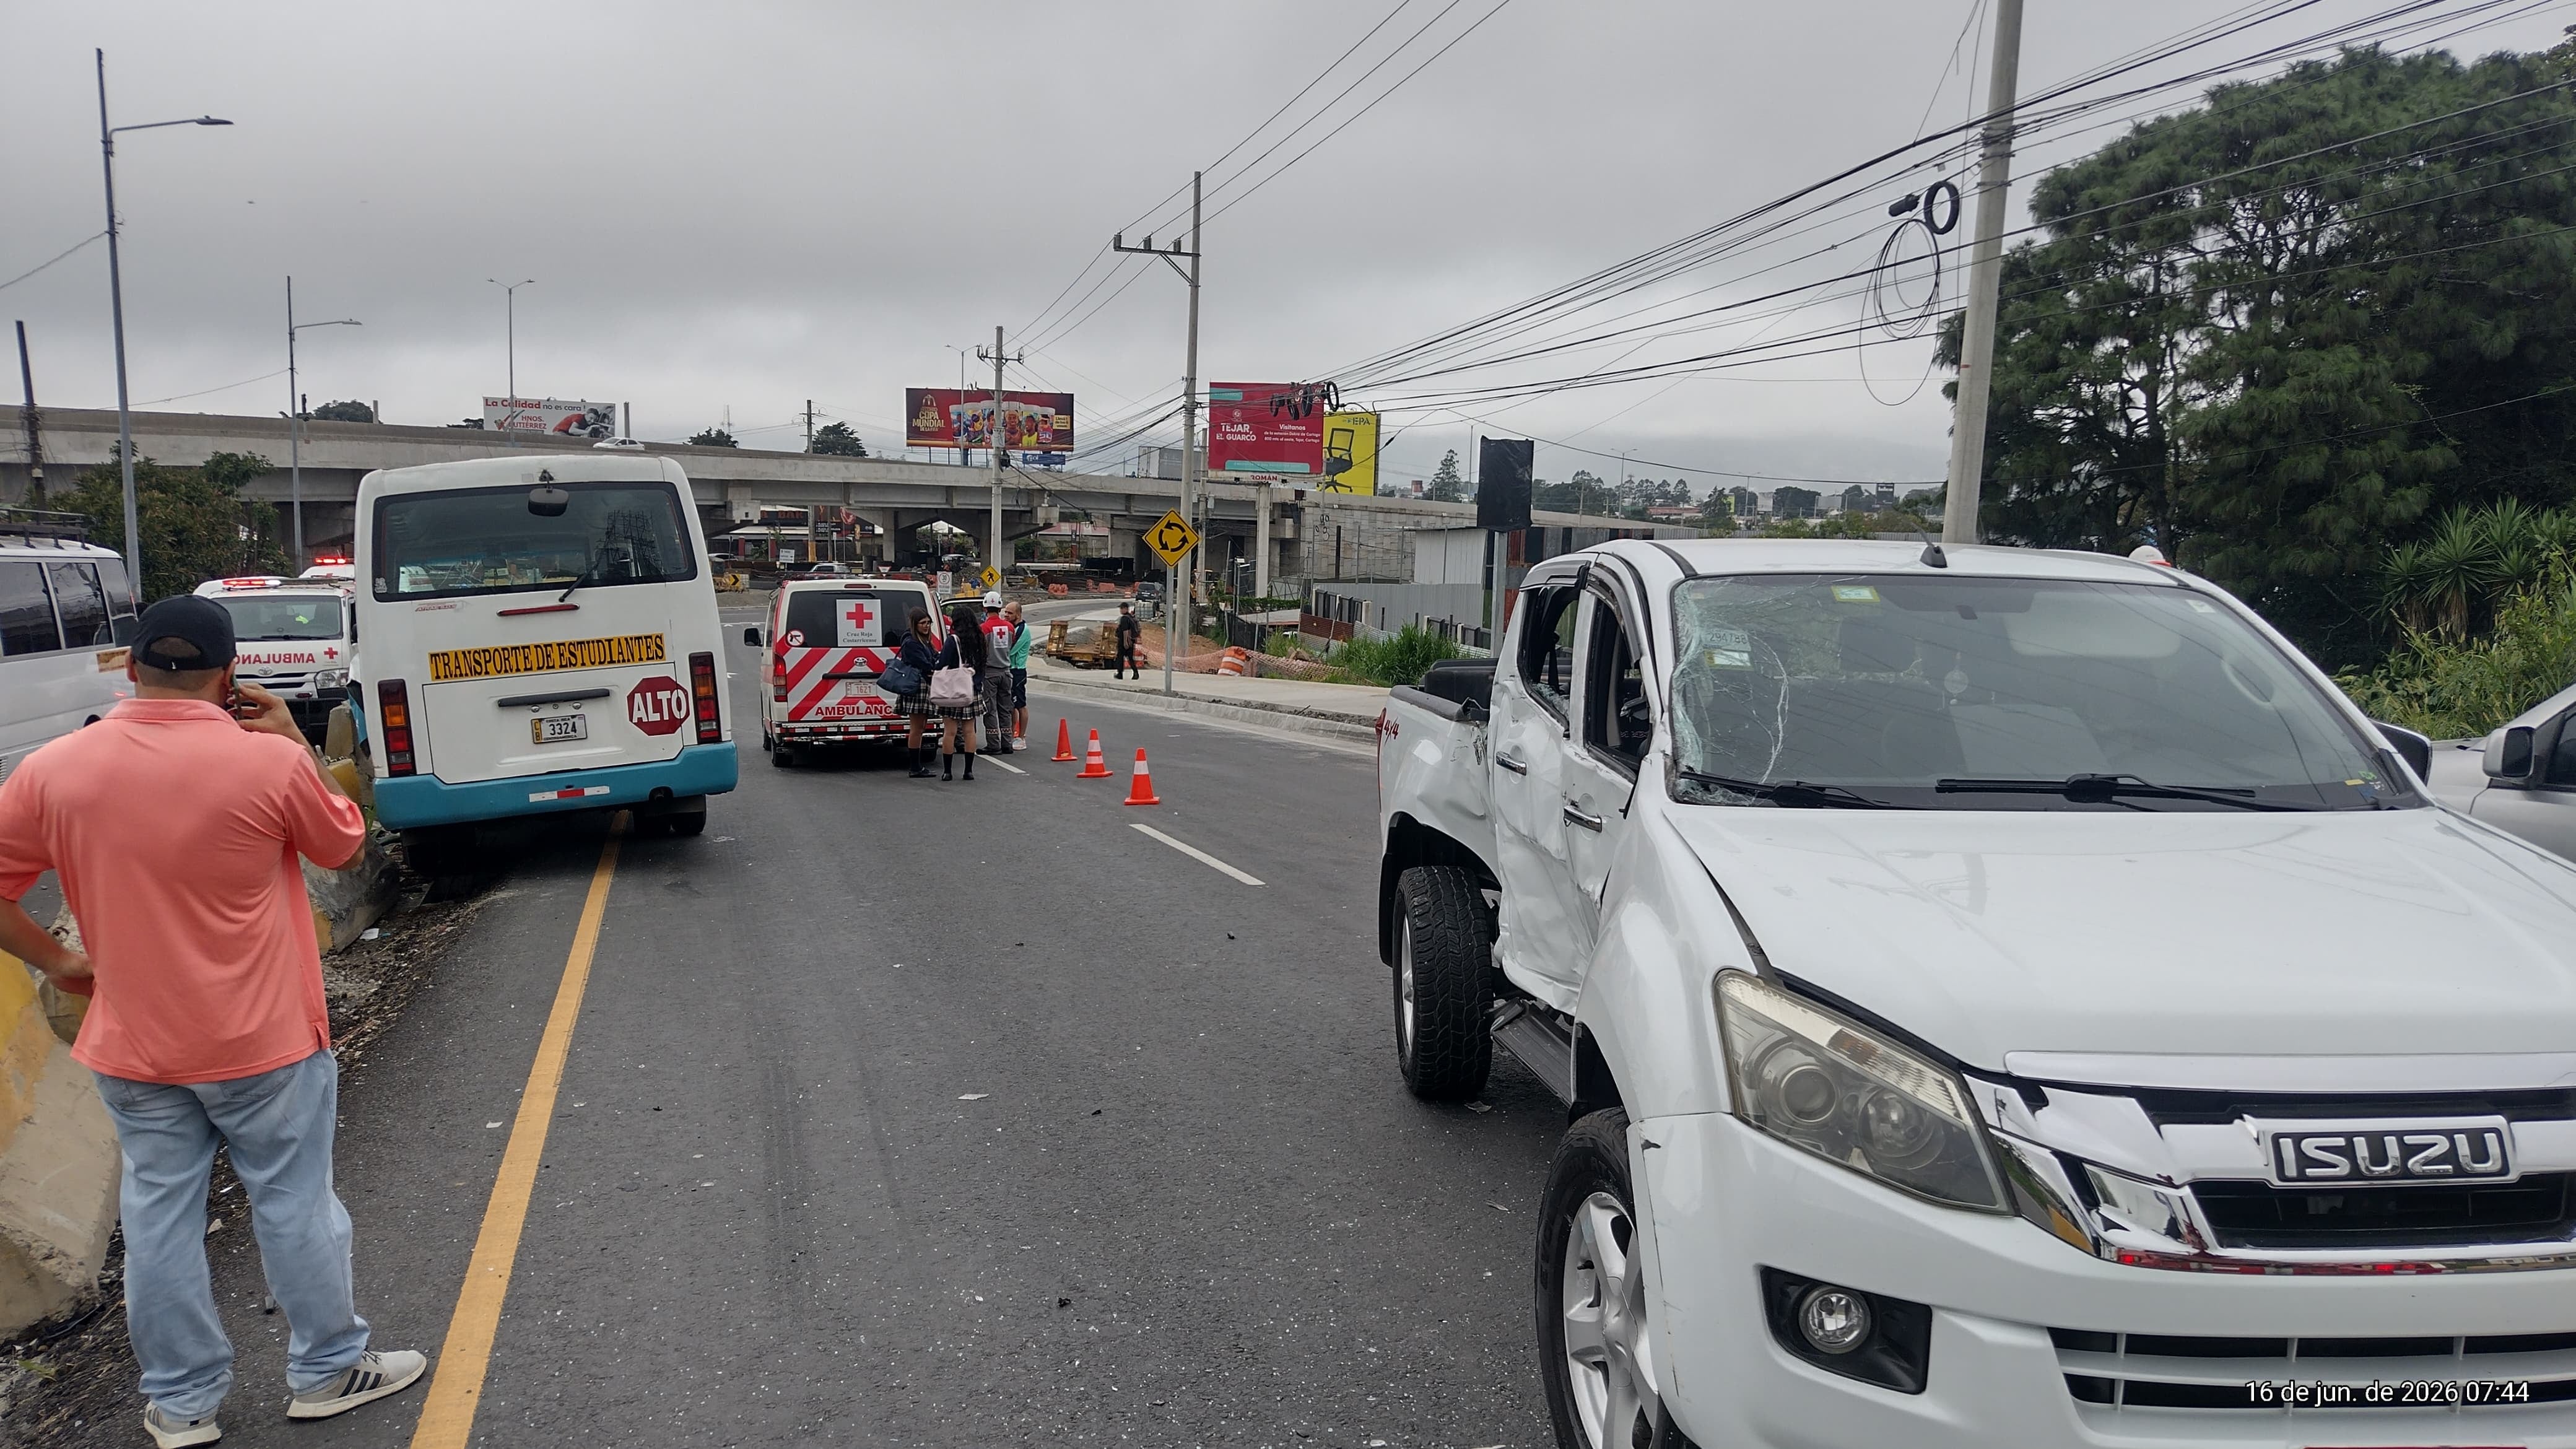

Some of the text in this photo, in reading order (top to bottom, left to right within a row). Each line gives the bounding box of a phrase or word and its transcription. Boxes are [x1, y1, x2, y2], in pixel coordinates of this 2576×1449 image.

[485, 398, 498, 407] La
[919, 411, 939, 419] COPA
[912, 418, 946, 427] MUNDIAL
[1221, 423, 1253, 434] TEJAR,
[1226, 433, 1256, 442] GUARCO
[430, 635, 664, 679] TRANSPORTE DE ESTUDIANTES
[856, 685, 871, 694] 1621
[632, 689, 687, 723] ALTO
[815, 705, 892, 716] AMBULANC
[549, 721, 577, 736] 3324
[2278, 1133, 2502, 1177] ISUZU
